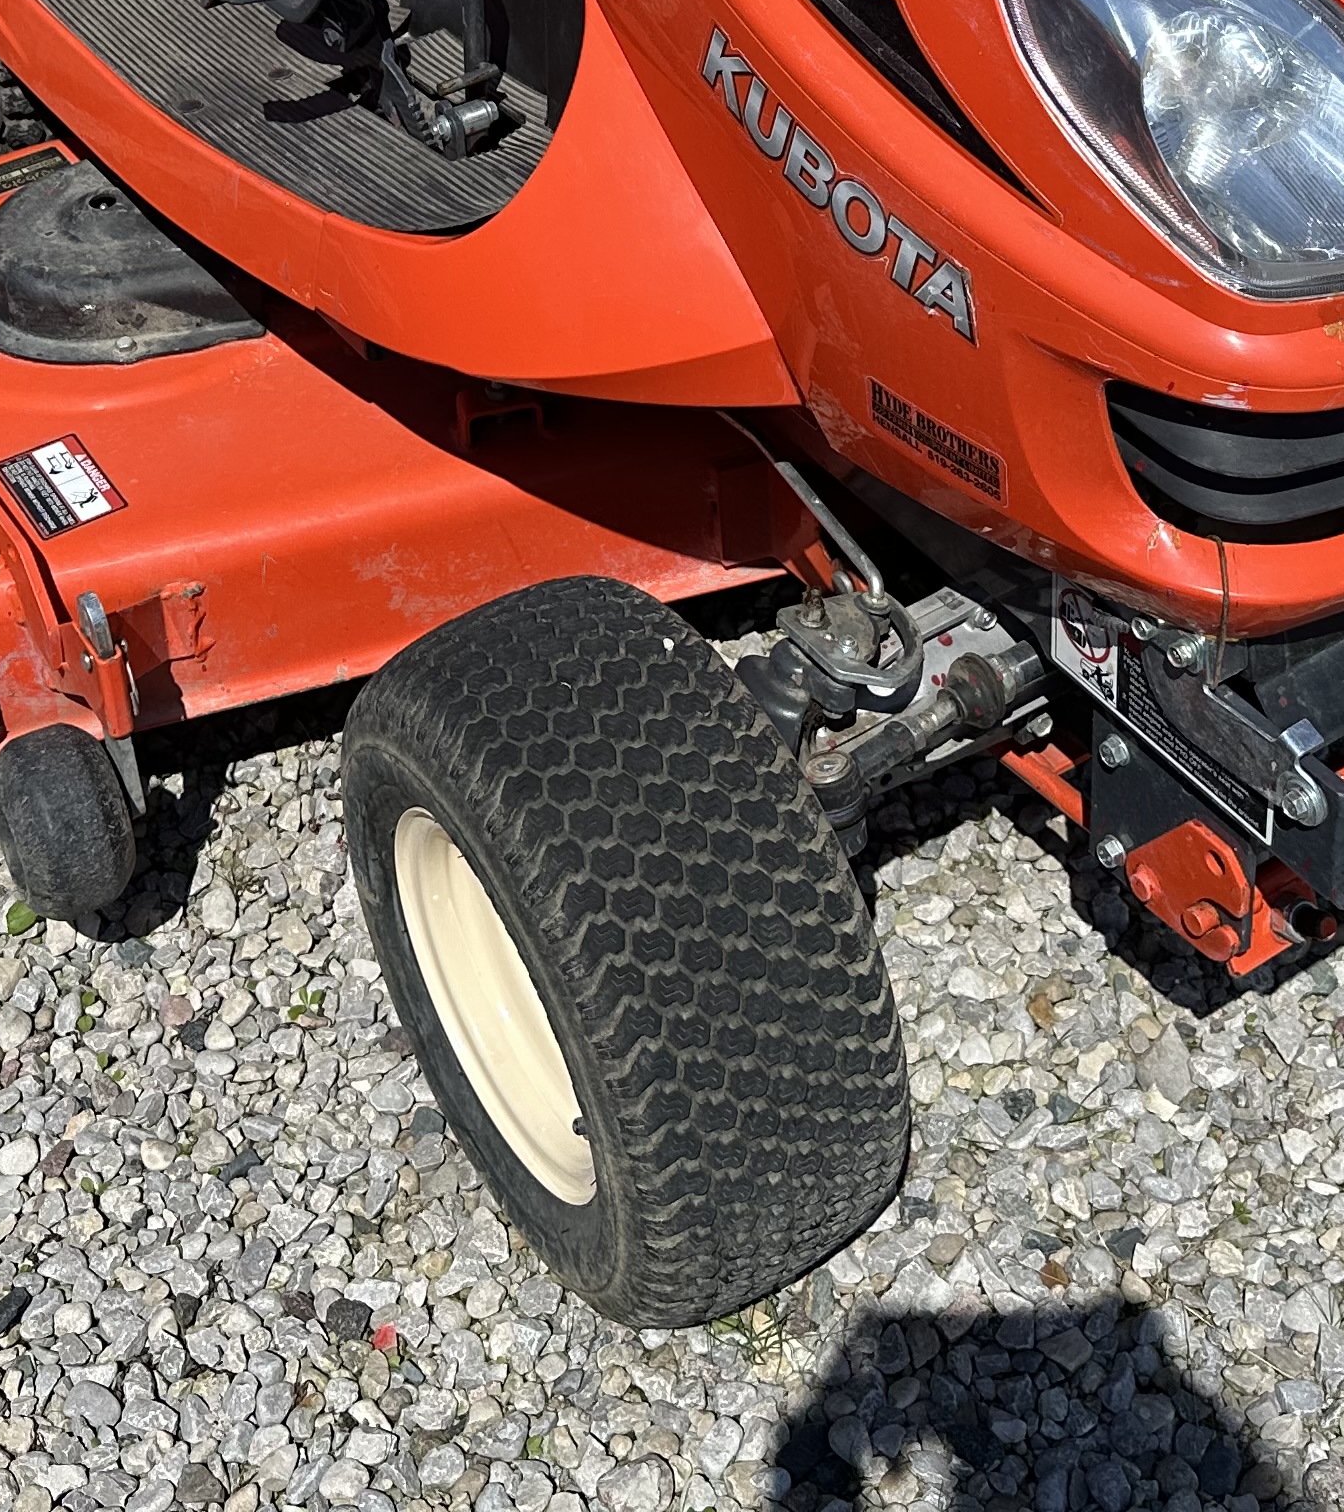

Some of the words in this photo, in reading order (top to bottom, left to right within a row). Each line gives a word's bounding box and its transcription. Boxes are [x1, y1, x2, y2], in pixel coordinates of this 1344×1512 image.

[701, 27, 977, 343] KUBOTA
[871, 381, 912, 418] HYDE
[916, 411, 1000, 475] BROTHERS
[872, 412, 923, 453] HENSALL
[80, 459, 112, 493] DANGER
